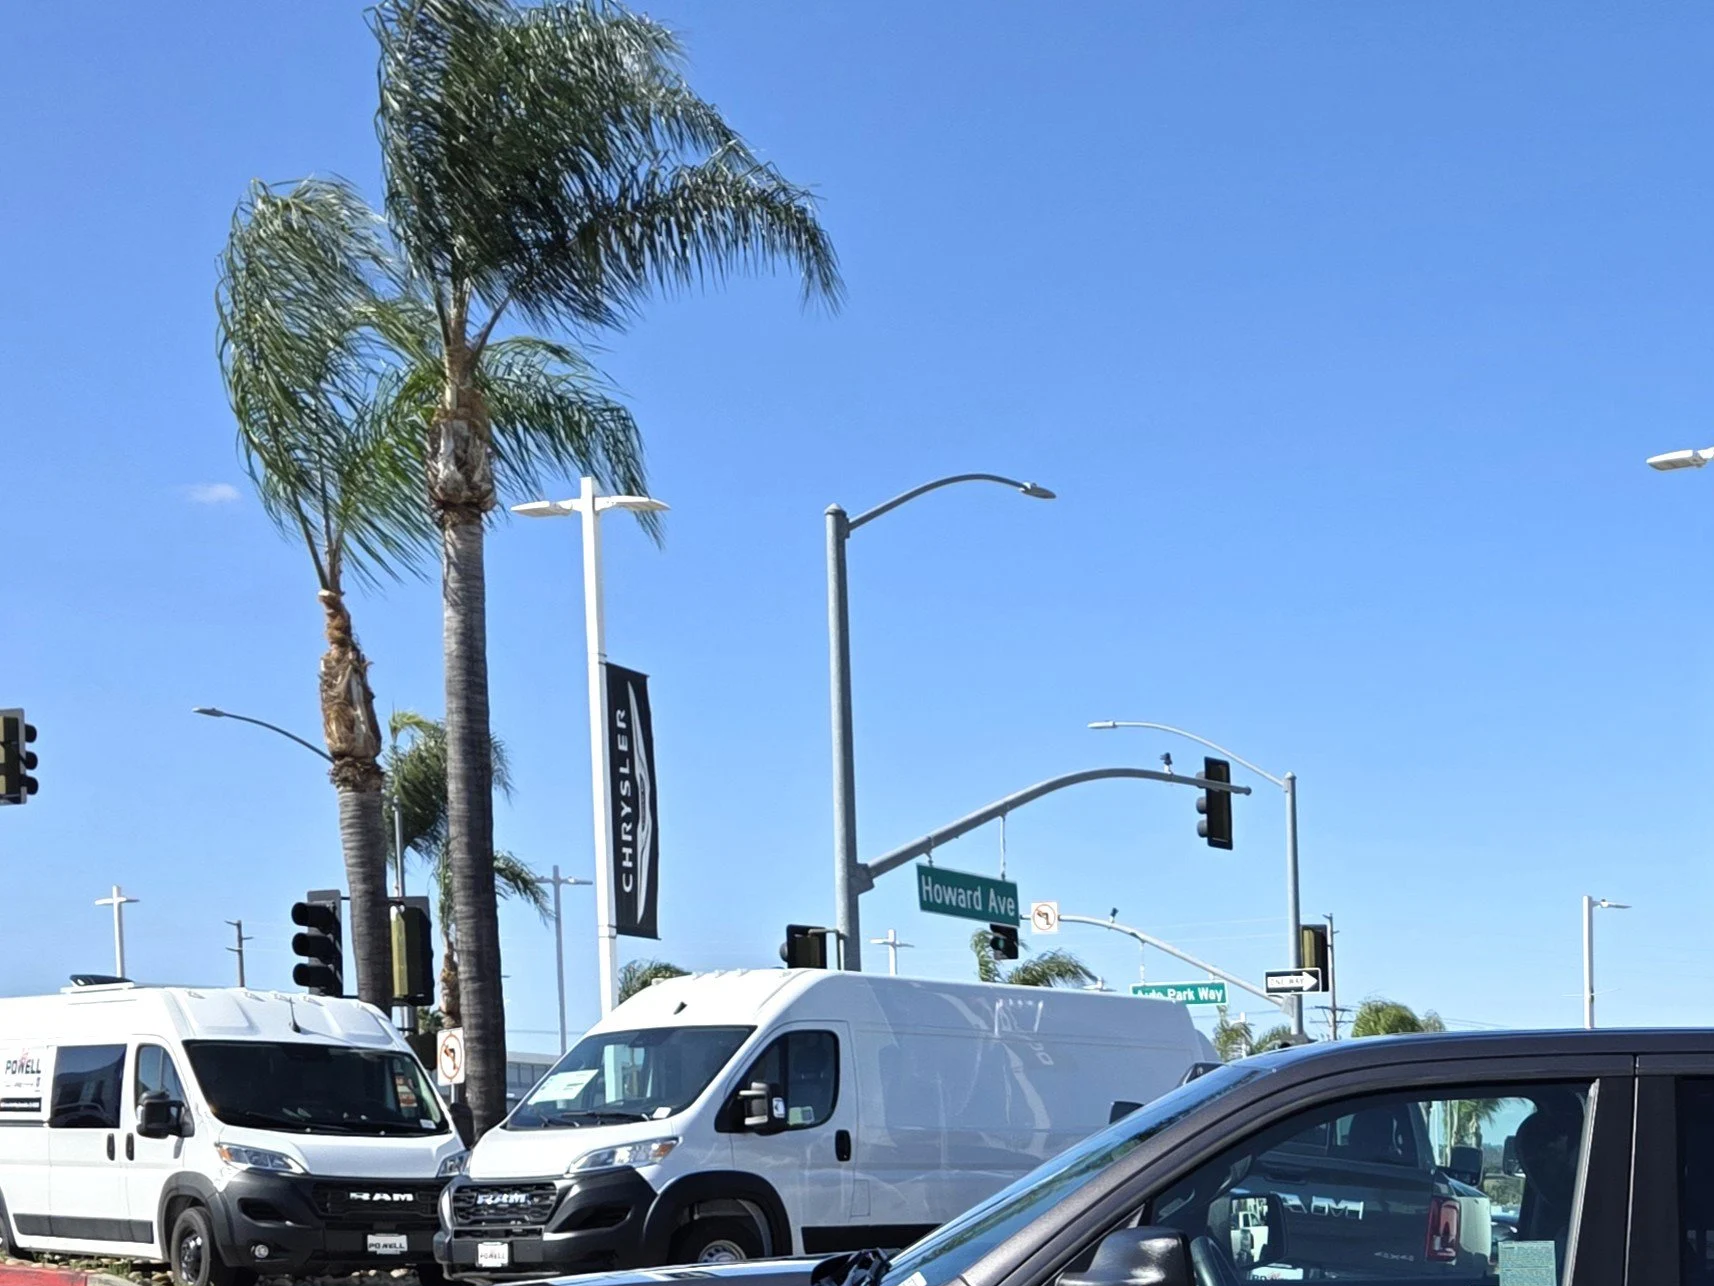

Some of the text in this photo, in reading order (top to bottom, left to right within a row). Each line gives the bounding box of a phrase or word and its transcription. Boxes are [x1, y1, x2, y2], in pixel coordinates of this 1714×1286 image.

[616, 708, 633, 893] CHRYSLER
[921, 875, 1015, 917] Howard Ave
[1167, 988, 1195, 1001] Park
[1197, 987, 1223, 1003] Way
[5, 1058, 41, 1075] POWELL
[350, 1192, 413, 1201] RAM
[476, 1192, 528, 1205] RAM
[1270, 1191, 1364, 1220] AM
